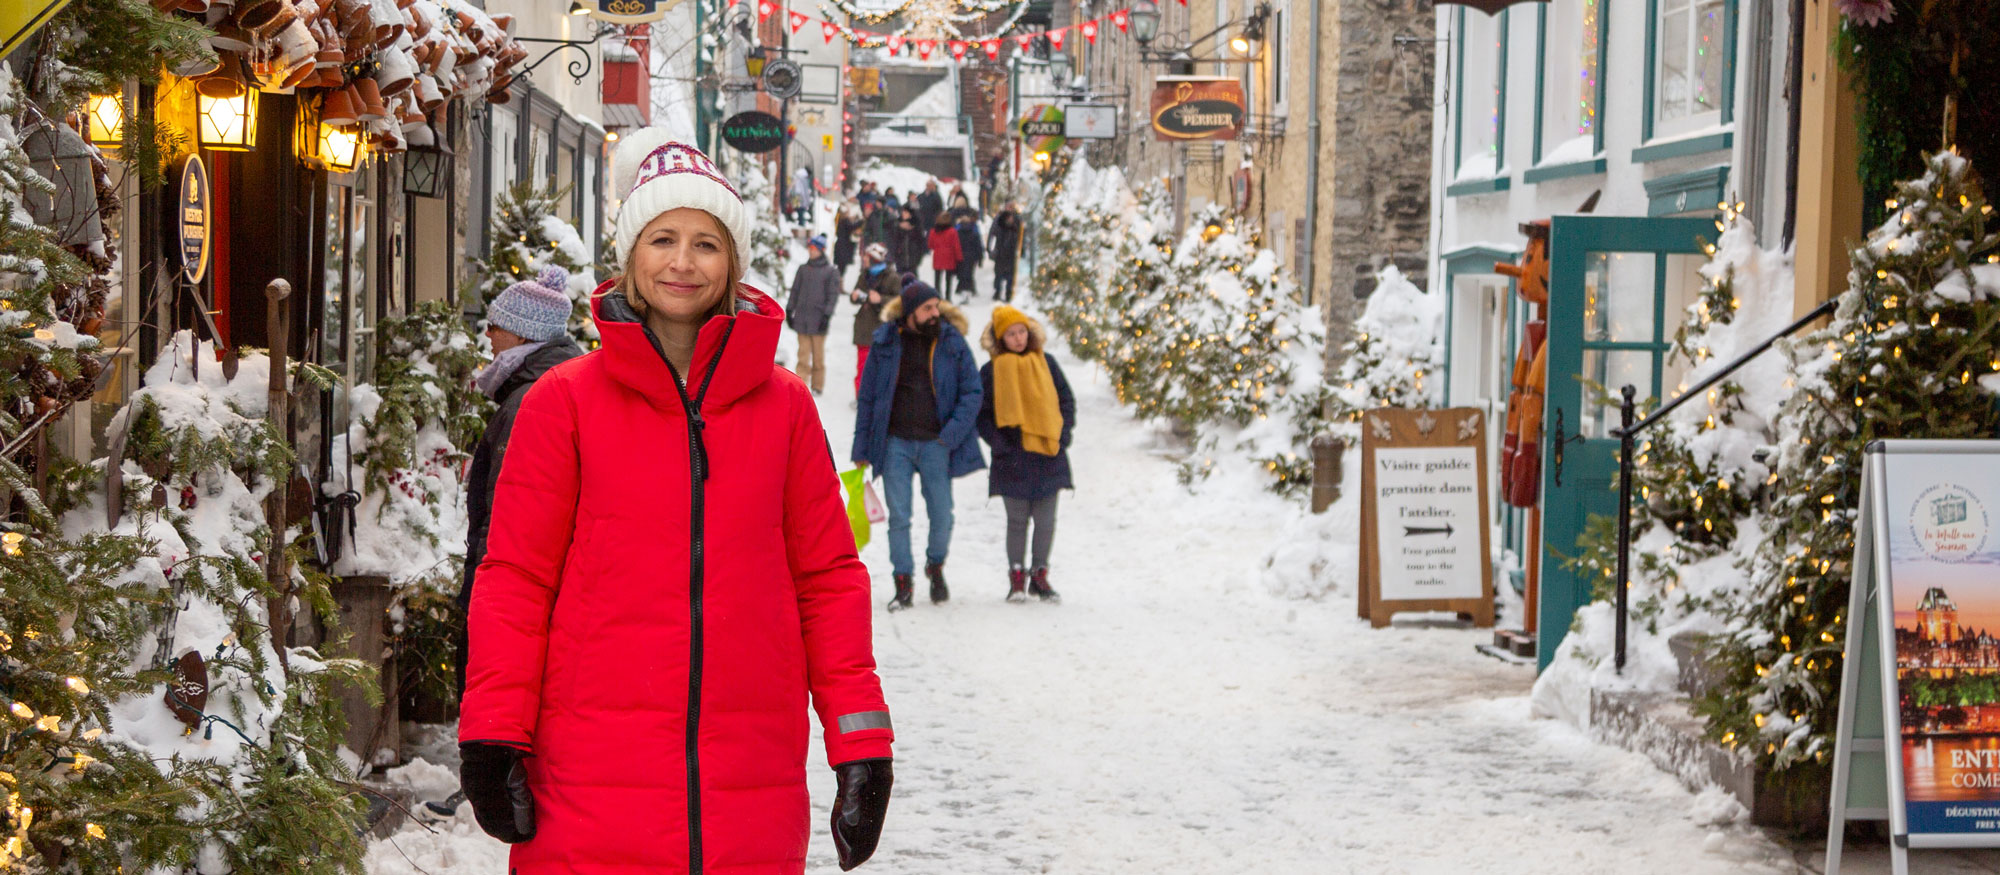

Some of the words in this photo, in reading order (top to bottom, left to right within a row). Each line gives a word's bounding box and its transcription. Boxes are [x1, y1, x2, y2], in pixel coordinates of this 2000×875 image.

[1027, 122, 1060, 135] ZAZOU
[1182, 113, 1235, 130] PERRIER
[1380, 459, 1421, 471] Visite
[1425, 458, 1472, 473] guidée
[1381, 484, 1437, 498] gratuite
[1440, 482, 1472, 494] dans
[1399, 506, 1456, 518] l'atelier.
[1403, 546, 1423, 555] Free
[1425, 546, 1457, 557] guided
[1406, 562, 1425, 571] tour
[1427, 561, 1437, 571] in
[1440, 561, 1454, 570] the
[1950, 749, 2000, 769] ENT
[1951, 771, 2000, 788] COME
[1975, 819, 1996, 830] FREE
